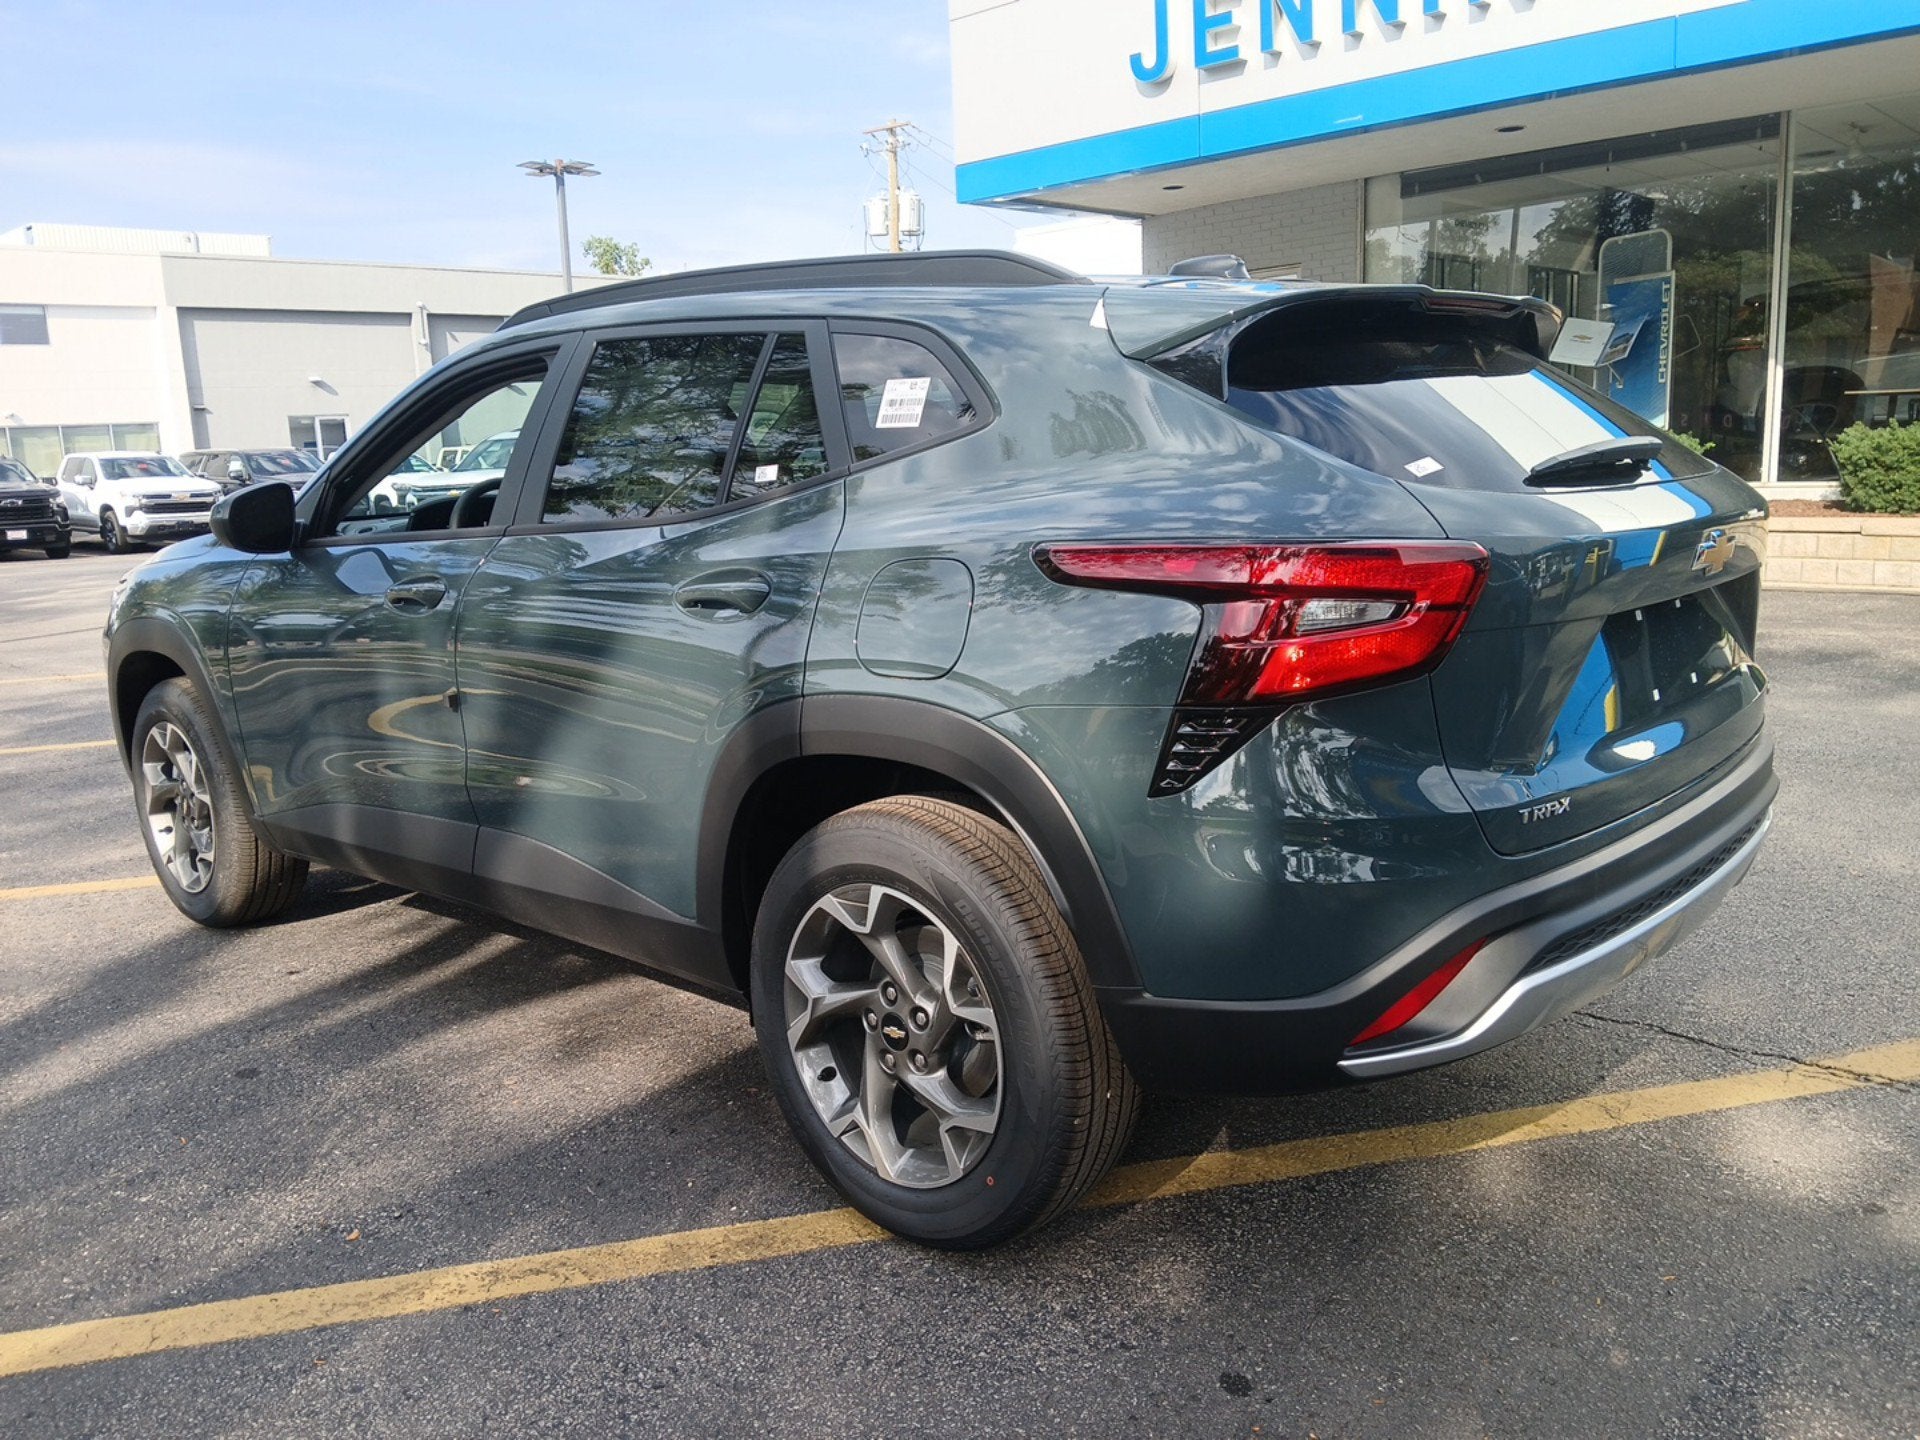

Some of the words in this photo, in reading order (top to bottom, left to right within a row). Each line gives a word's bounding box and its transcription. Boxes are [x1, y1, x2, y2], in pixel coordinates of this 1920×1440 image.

[1129, 0, 1482, 84] JEN
[1658, 281, 1670, 383] CHEVROLET
[1519, 797, 1571, 824] TRAX
